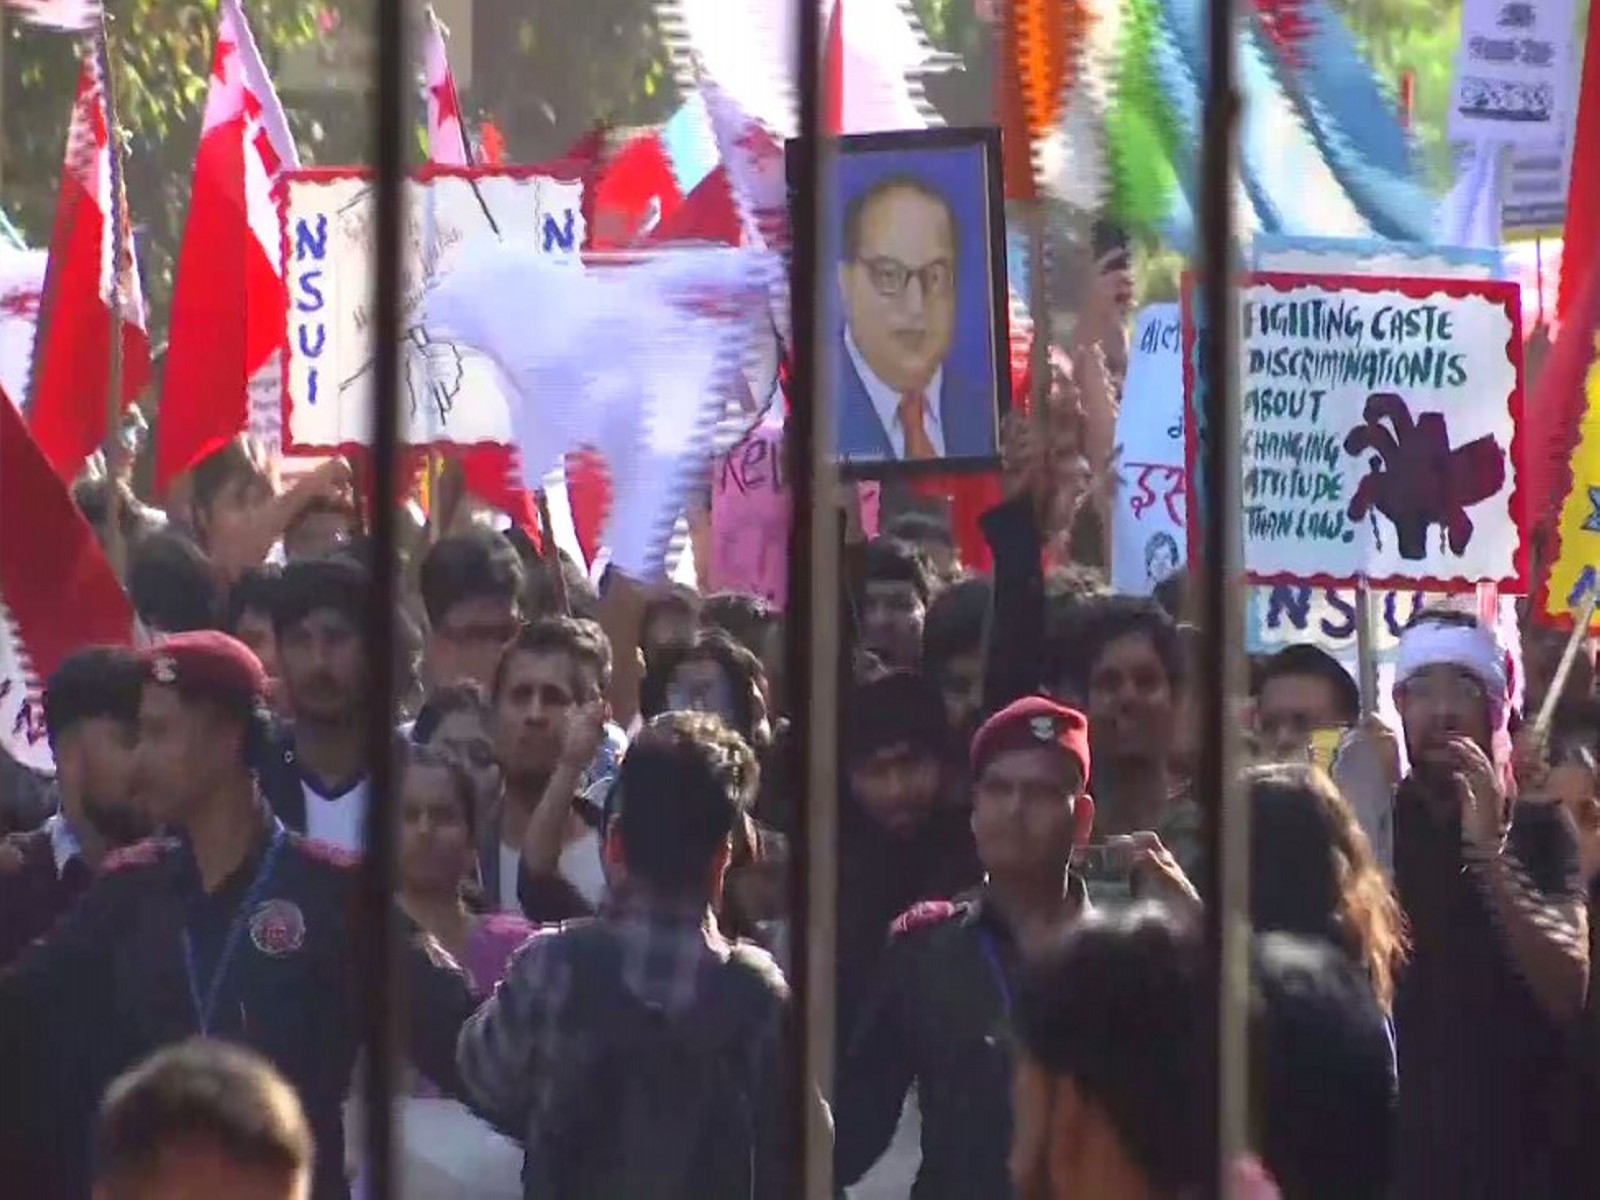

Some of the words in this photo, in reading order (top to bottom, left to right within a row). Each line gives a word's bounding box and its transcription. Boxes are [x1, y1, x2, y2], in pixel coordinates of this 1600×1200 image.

[296, 213, 327, 405] NSUI
[1371, 305, 1453, 341] CASTE
[1243, 388, 1327, 424] ABOUT
[1243, 467, 1345, 505] ATTITUDE
